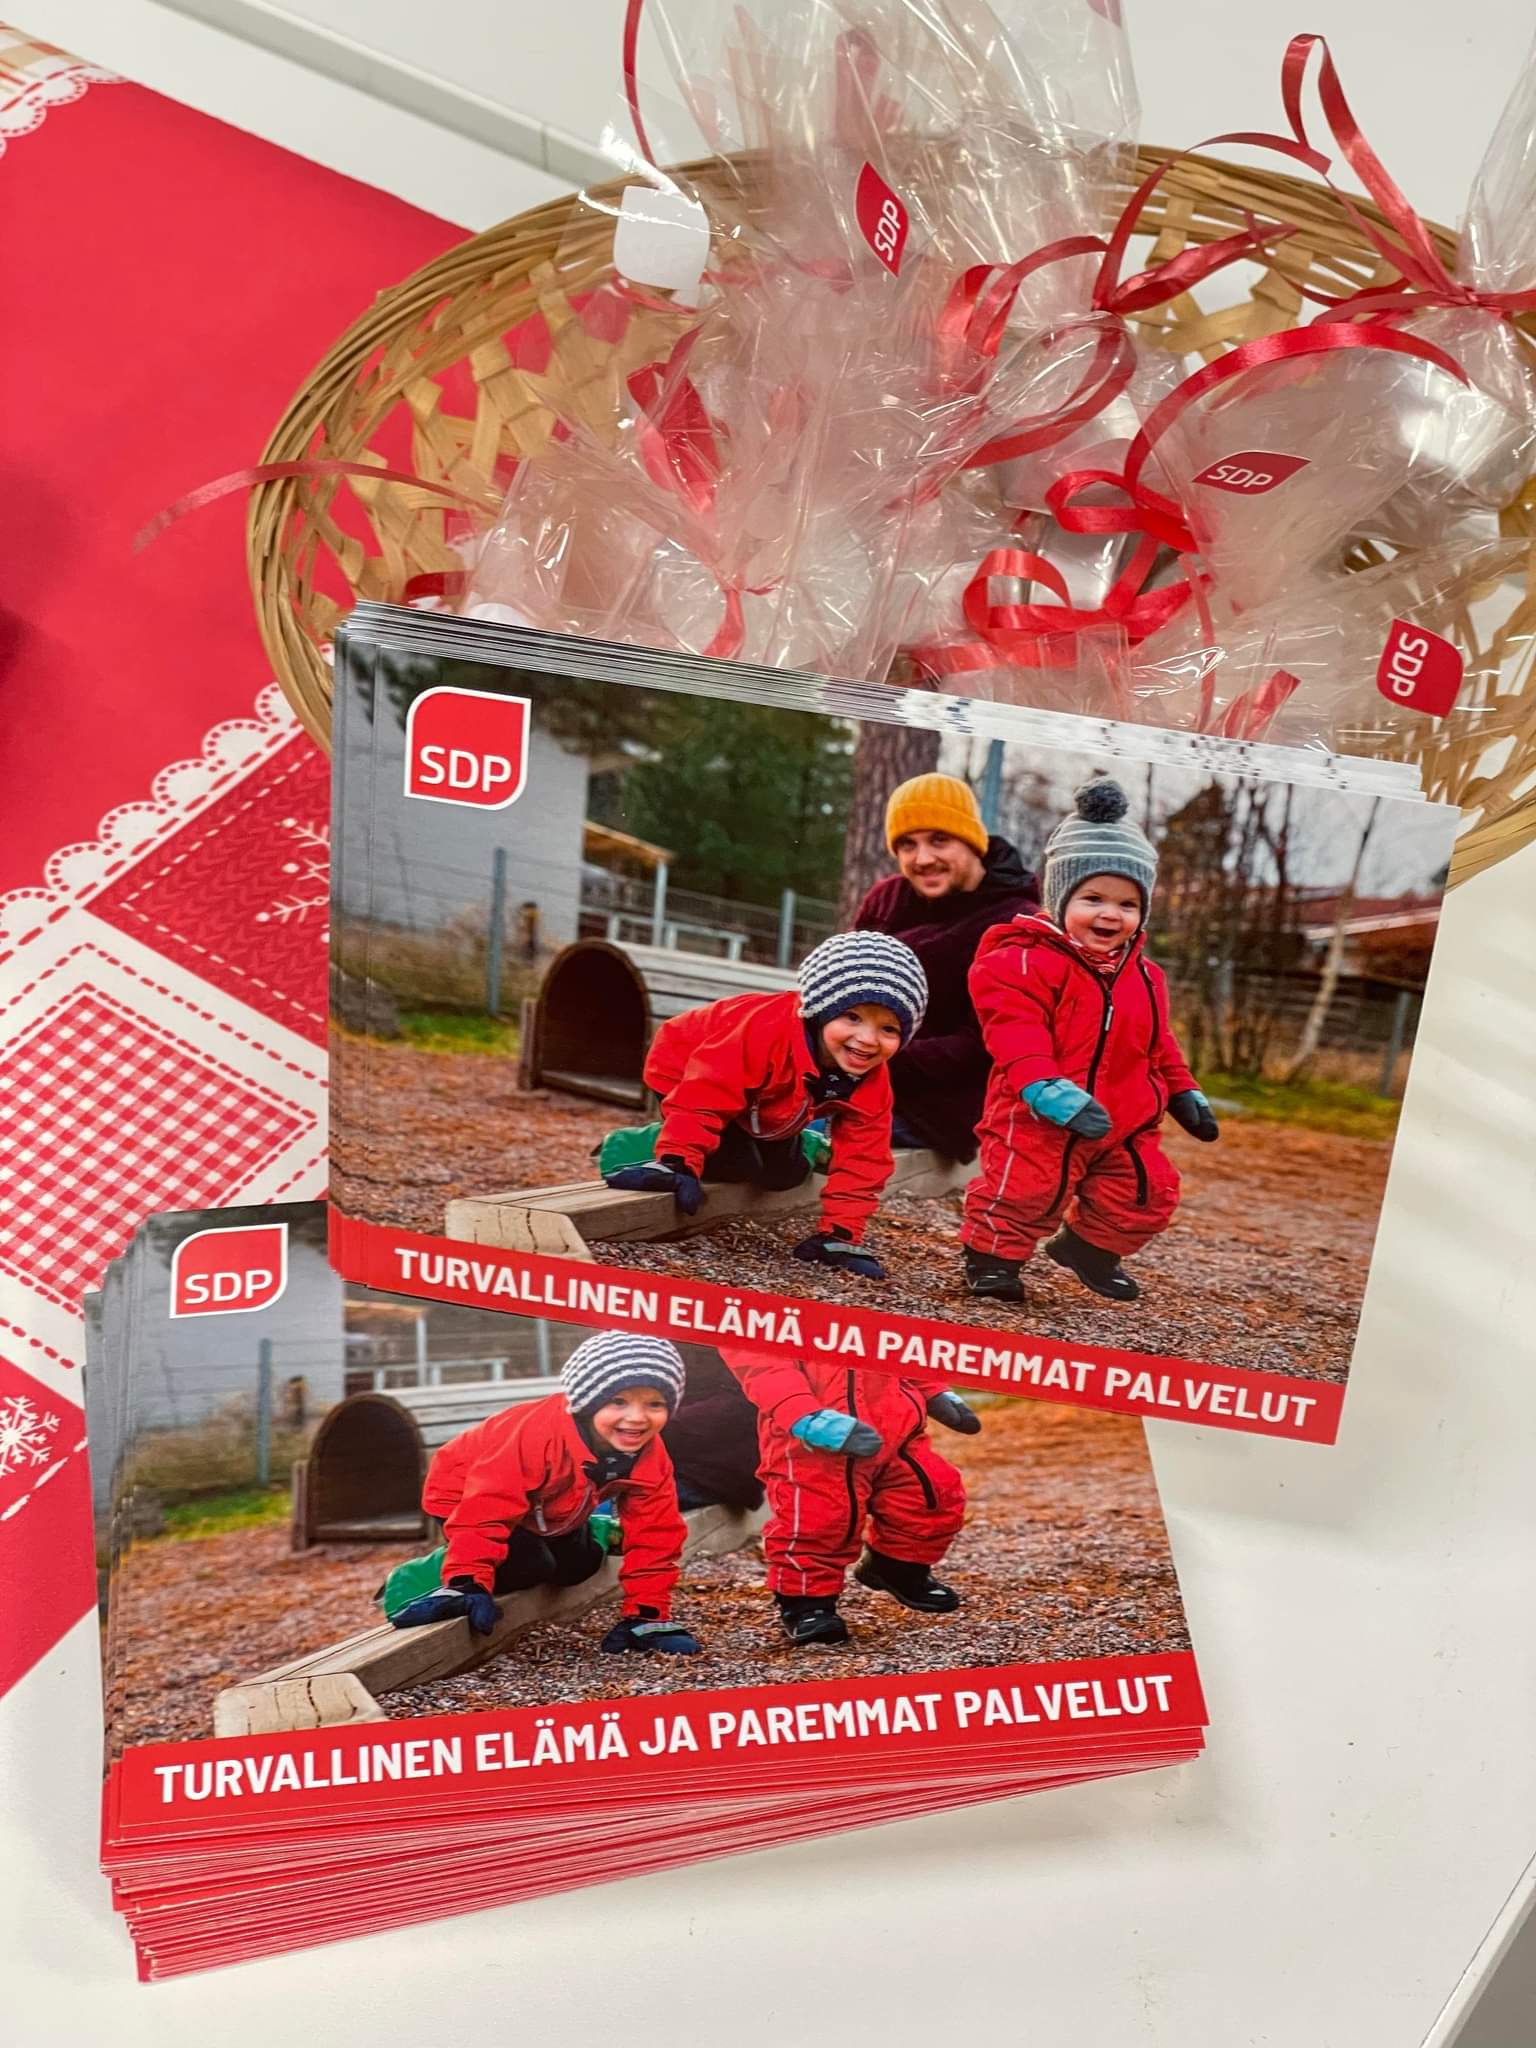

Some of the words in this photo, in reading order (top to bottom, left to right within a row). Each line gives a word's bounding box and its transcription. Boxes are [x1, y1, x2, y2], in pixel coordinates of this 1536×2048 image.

[874, 199, 901, 262] SDP
[1207, 465, 1273, 488] SDP
[1387, 632, 1429, 697] SDP
[419, 745, 513, 793] SDP
[184, 1269, 274, 1303] SDP
[395, 1248, 659, 1322] TURVALLINEN
[669, 1295, 803, 1346] ELÄMÄ
[813, 1322, 865, 1357] JA
[877, 1330, 1096, 1392] PAREMMAT
[1105, 1367, 1317, 1426] PALVELUT
[154, 1736, 462, 1803] TURVALLINEN
[475, 1711, 629, 1772] ELÄMÄ
[639, 1715, 699, 1756] JA
[709, 1693, 942, 1750] PAREMMAT
[954, 1674, 1172, 1728] PALVELUT
